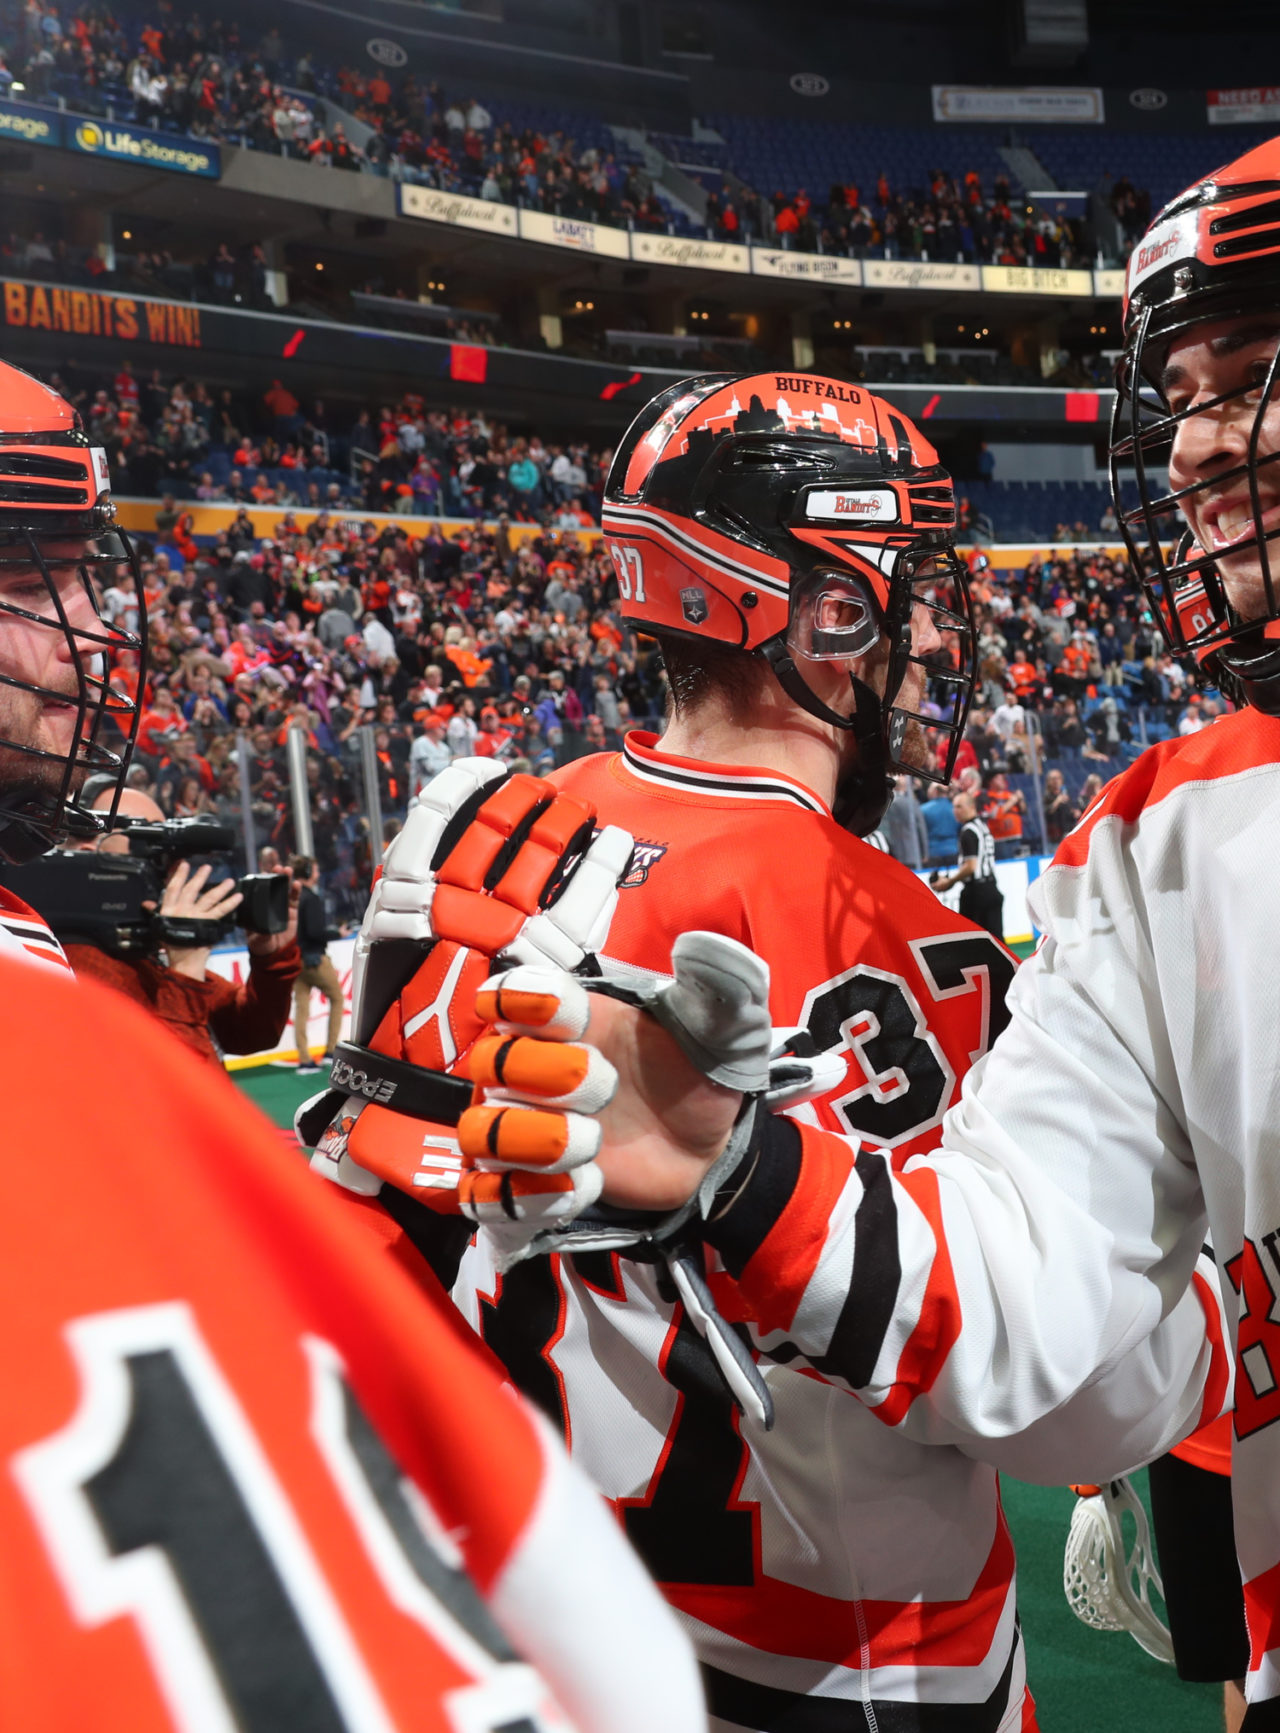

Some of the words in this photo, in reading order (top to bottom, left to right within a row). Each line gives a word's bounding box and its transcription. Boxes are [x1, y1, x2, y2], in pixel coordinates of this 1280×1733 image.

[1218, 90, 1261, 105] NEED
[4, 281, 139, 341] BANDITS
[146, 301, 202, 348] WIN!
[775, 376, 861, 405] BUFFALO
[834, 495, 881, 513] BANDITS
[610, 545, 647, 602] 37
[798, 931, 1021, 1149] 37
[331, 1058, 398, 1104] EPOCH
